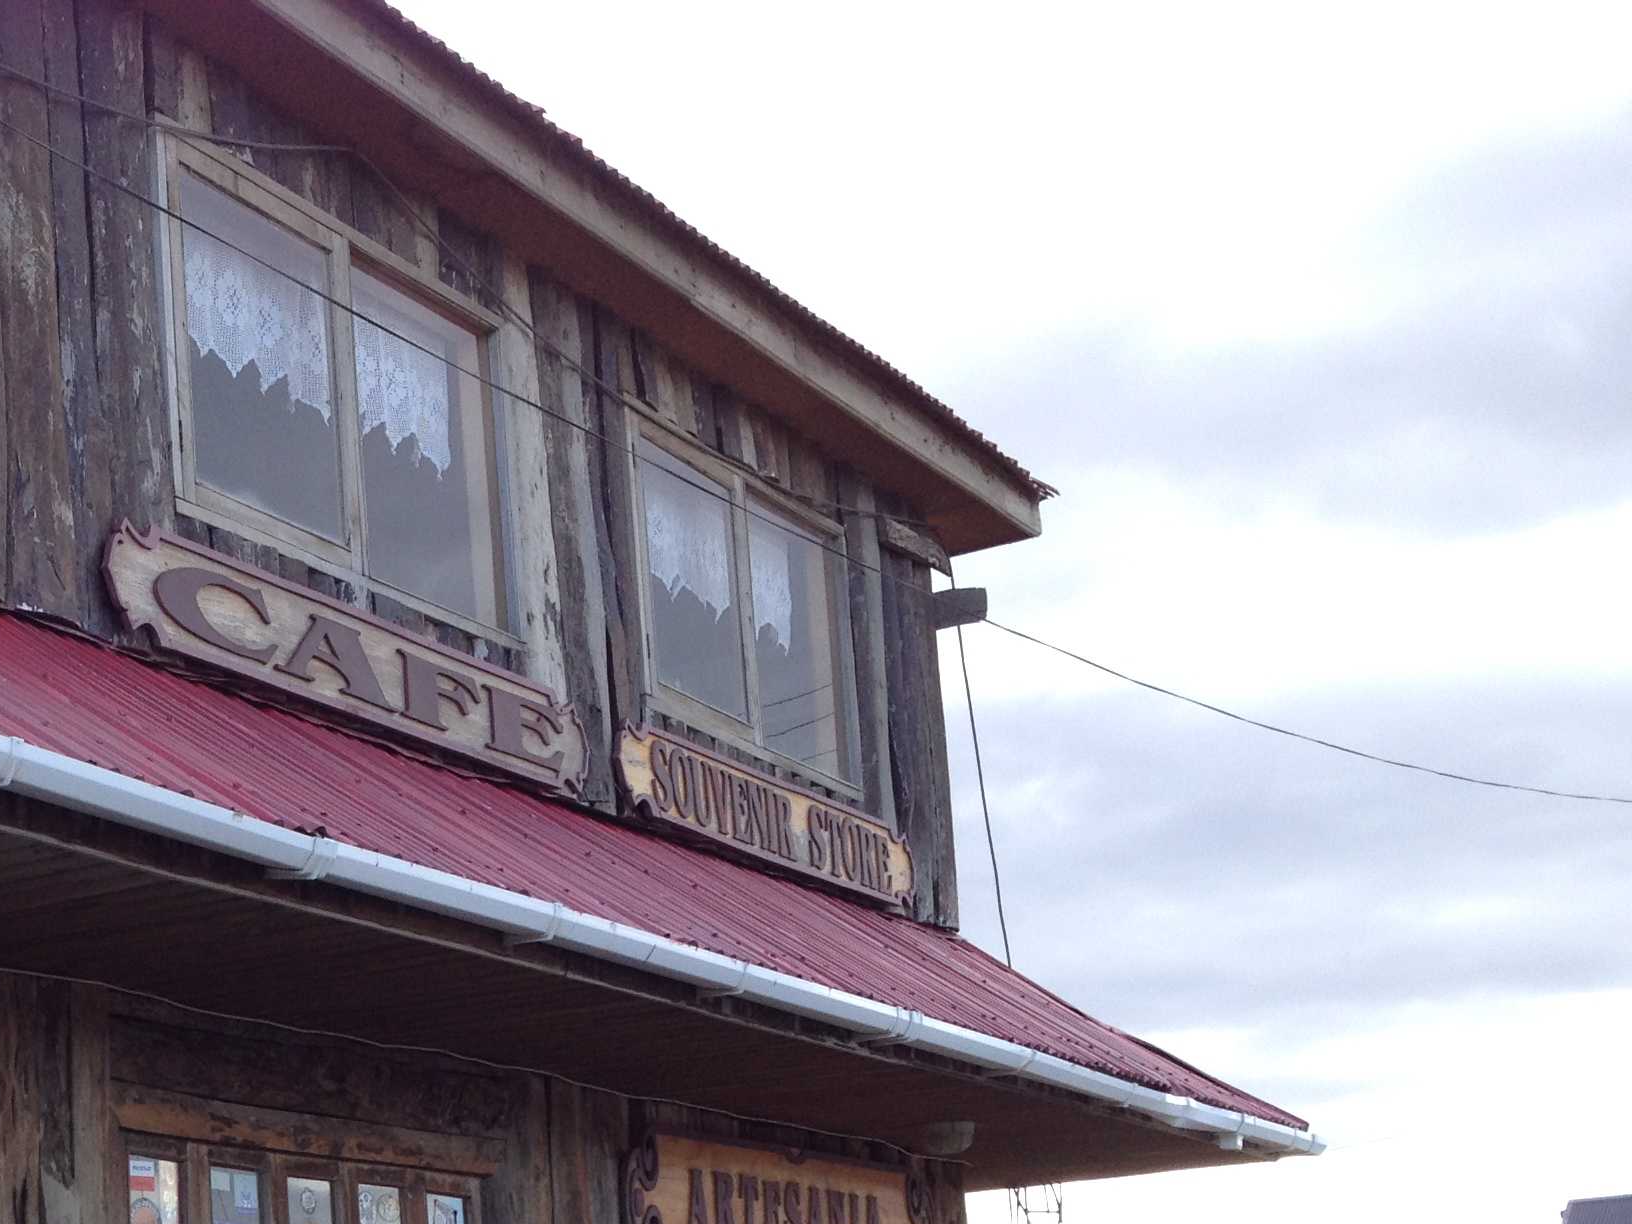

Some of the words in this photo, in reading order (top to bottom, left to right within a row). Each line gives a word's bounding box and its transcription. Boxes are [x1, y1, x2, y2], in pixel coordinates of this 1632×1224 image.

[153, 566, 565, 775] CAFE
[648, 736, 795, 864] SOUVENIR
[807, 809, 894, 894] STORE
